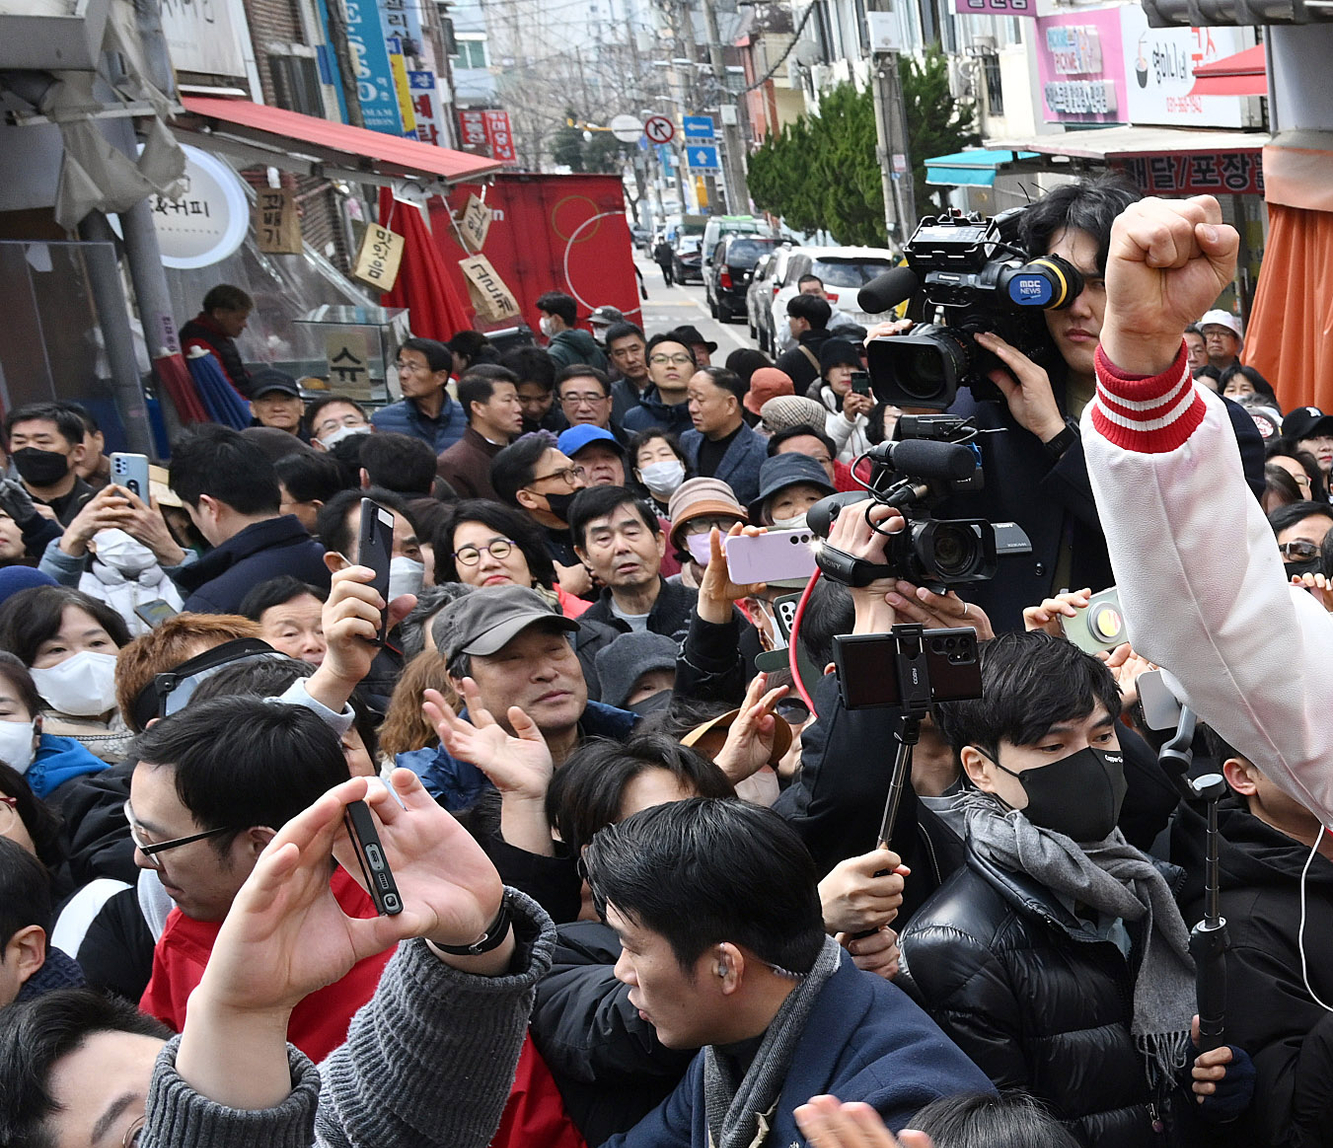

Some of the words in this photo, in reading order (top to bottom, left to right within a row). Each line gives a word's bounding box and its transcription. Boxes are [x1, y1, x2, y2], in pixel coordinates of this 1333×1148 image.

[1020, 280, 1041, 288] MBC
[330, 347, 365, 382] 슈
[821, 556, 842, 571] SONY
